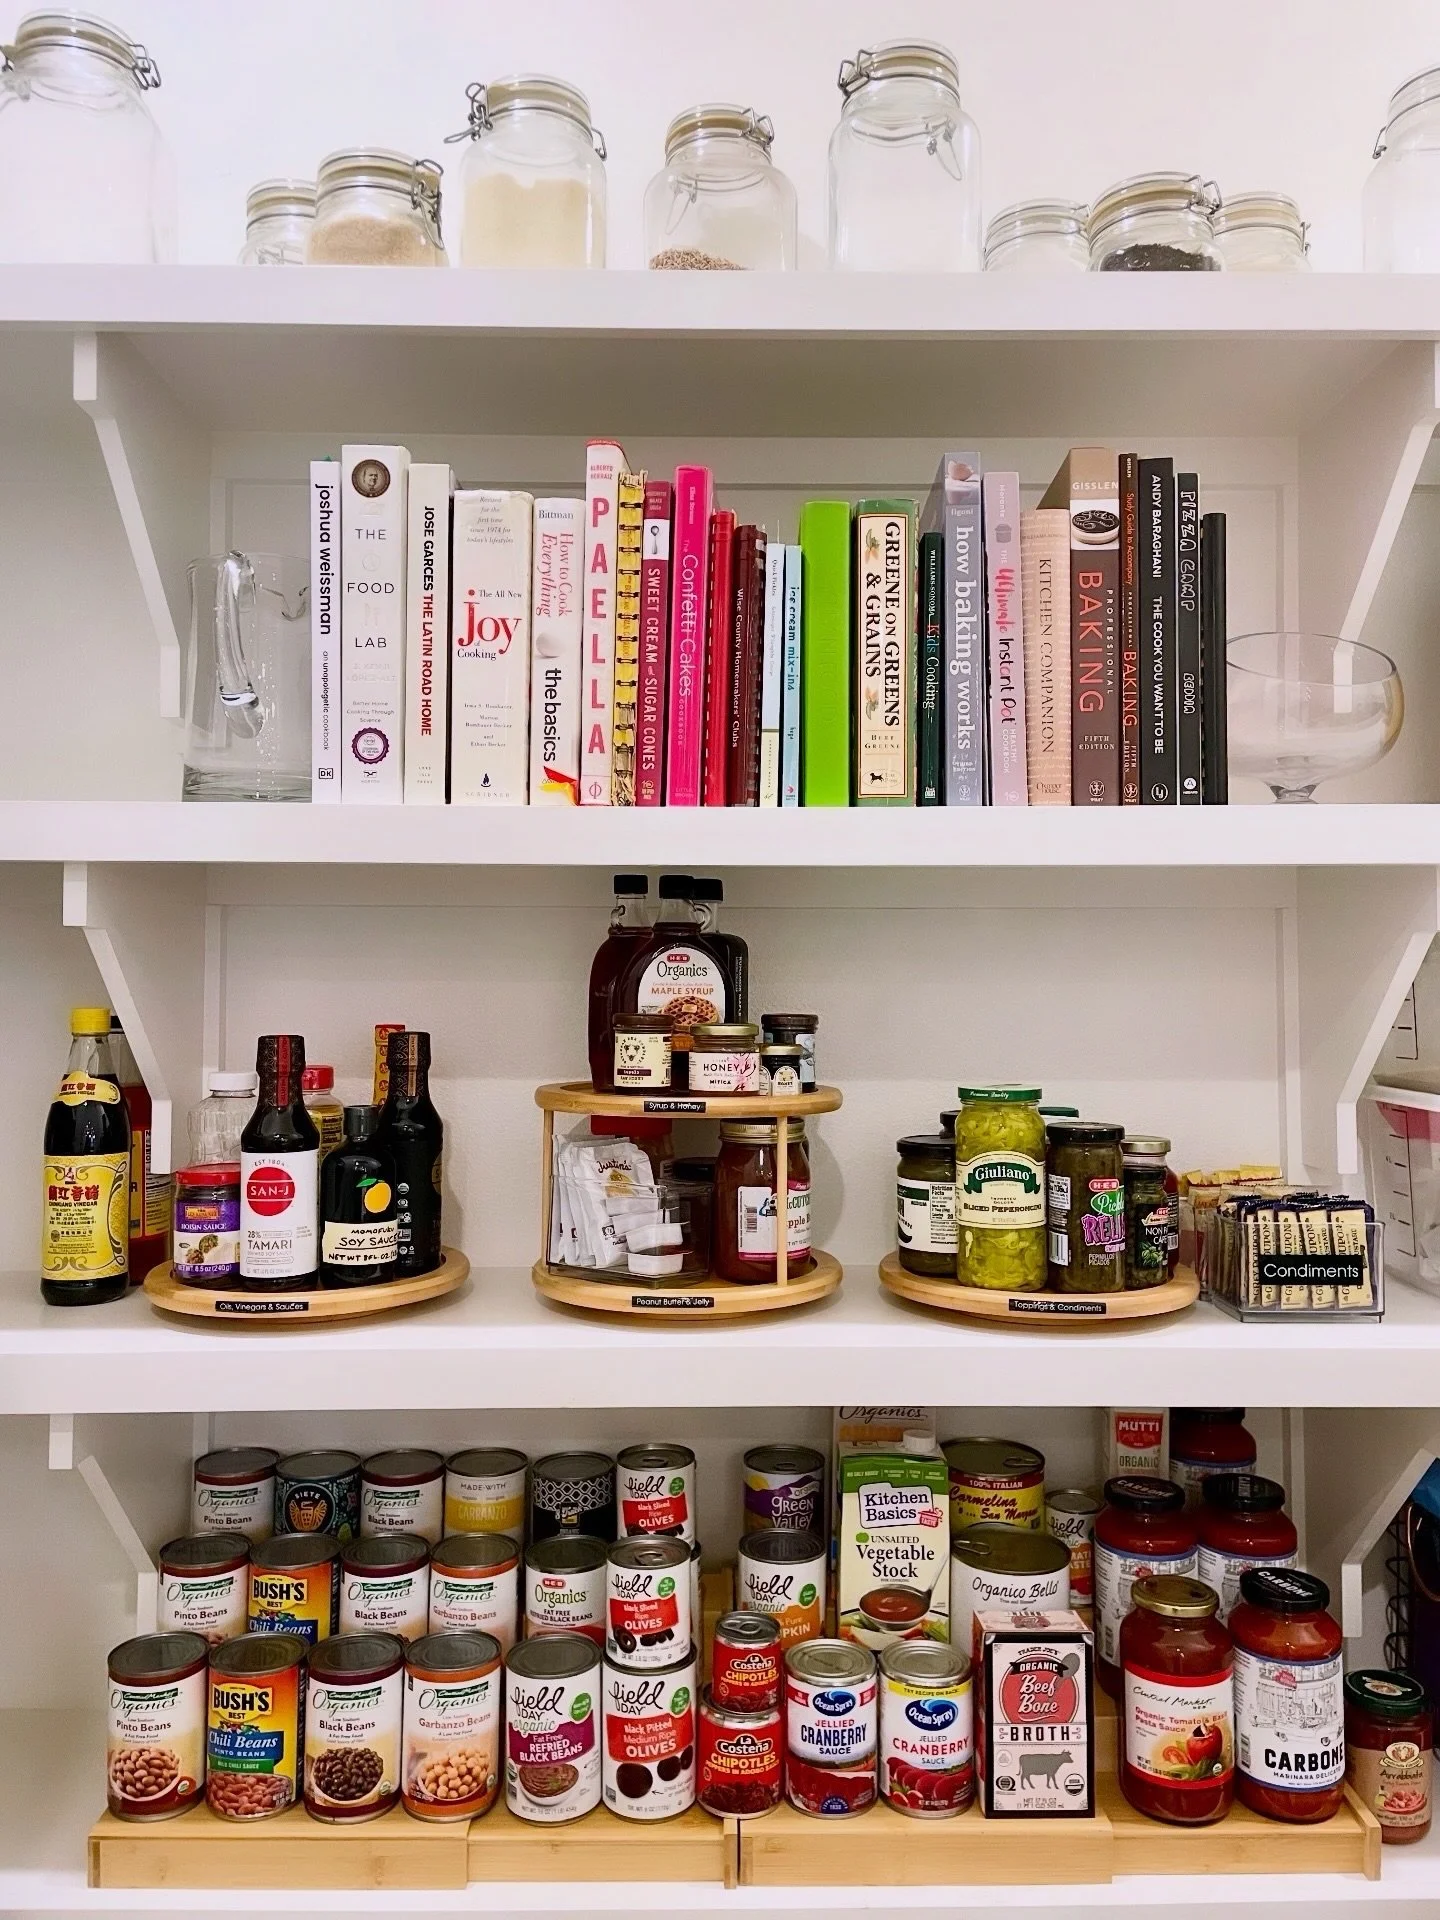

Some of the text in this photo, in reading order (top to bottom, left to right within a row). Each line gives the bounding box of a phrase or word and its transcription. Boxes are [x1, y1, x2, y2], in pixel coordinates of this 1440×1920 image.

[1072, 481, 1119, 490] GISSLEN
[355, 528, 387, 540] THE
[1126, 493, 1135, 585] Study Guide to Accompany
[315, 484, 334, 635] joshua weissman
[1180, 490, 1197, 612] PIZZA CAMP
[536, 533, 558, 617] Everything
[347, 582, 395, 594] FOOD
[681, 554, 699, 632] Confetti
[421, 506, 434, 736] JOSE GARCES THE LATIN ROAD HOME
[1151, 474, 1164, 754] ANDY BARAGHANI THE COOK YOU WANT TO BE
[588, 497, 610, 754] PAELLA
[735, 615, 744, 649] County
[865, 572, 882, 678] & GRAINS
[884, 522, 900, 727] GREENE ON GREENS
[355, 637, 387, 648] LAB
[787, 587, 800, 691] ice cream mix-ins
[950, 525, 978, 750] how baking works
[1079, 571, 1105, 713] BAKING
[1106, 588, 1114, 694] PROFESSIONAL
[457, 649, 497, 660] Cooking
[1039, 559, 1055, 753] KITCHEN COMPANION
[642, 568, 661, 770] SWEET CREAM SUGAR CONES
[678, 639, 697, 697] Cakes
[998, 638, 1015, 692] Instant
[733, 651, 743, 718] Homemakers'
[1123, 651, 1138, 727] BAKING
[543, 668, 562, 762] the basics
[1000, 698, 1017, 725] Pot
[732, 720, 740, 748] Clubs
[656, 961, 708, 981] Organics
[651, 987, 714, 996] MAPLE SYRUP
[703, 1063, 740, 1072] HONEY
[649, 1102, 669, 1111] Syrup
[677, 1103, 701, 1111] Honey
[597, 1158, 632, 1173] Justin's
[974, 1165, 1030, 1182] Giuliano
[250, 1184, 289, 1198] SAN-J
[247, 1240, 293, 1250] TAMARI
[339, 1231, 403, 1247] SOY SAUCE
[1263, 1263, 1359, 1278] Condiments
[235, 1303, 267, 1312] Vinegars
[267, 1303, 274, 1311] &
[275, 1302, 304, 1311] Sauces
[636, 1297, 662, 1306] Peanut
[662, 1297, 684, 1306] Butter
[692, 1297, 710, 1307] Jelly
[1014, 1300, 1049, 1311] Toppings
[1057, 1302, 1102, 1312] Condiments
[1118, 1421, 1160, 1432] MUTTI
[1119, 1455, 1159, 1469] ORGANIC
[864, 1491, 929, 1507] Kitchen
[949, 1486, 1018, 1508] Carmelina
[638, 1515, 674, 1528] OLIVES
[865, 1506, 917, 1522] Basics
[871, 1535, 920, 1544] UNSALTED
[855, 1544, 935, 1564] Vegetable
[872, 1562, 919, 1578] Stock
[253, 1579, 305, 1601] BUSH'S
[972, 1576, 1058, 1602] Organico Bello
[1257, 1570, 1314, 1598] CARBONE
[534, 1584, 587, 1608] Organics
[174, 1608, 228, 1620] Pinto Beans
[355, 1609, 408, 1621] Black Beans
[556, 1609, 571, 1617] FREE
[623, 1618, 663, 1630] OLIVES
[725, 1667, 777, 1682] CHIPOTLES
[1019, 1662, 1059, 1673] ORGANIC
[1020, 1674, 1056, 1697] Beef
[213, 1686, 271, 1712] BUSH'S
[1018, 1694, 1058, 1714] Bone
[1132, 1686, 1216, 1707] Central Market
[228, 1711, 246, 1720] BEST
[418, 1712, 492, 1730] Garbanzo Beans
[520, 1710, 546, 1721] DAY
[815, 1719, 855, 1728] JELLIED
[116, 1719, 172, 1732] Pinto Beans
[318, 1719, 376, 1732] Black Beans
[1009, 1725, 1071, 1742] BROTH
[209, 1730, 279, 1749] Chili Beans
[800, 1723, 867, 1747] CRANBERRY
[918, 1735, 947, 1743] JELLIED
[214, 1748, 235, 1757] PINTO
[519, 1743, 583, 1763] BLACK BEANS
[529, 1739, 570, 1753] REFRIED
[625, 1738, 677, 1758] OLIVES
[719, 1742, 769, 1755] Costeña
[819, 1746, 852, 1755] SAUCE
[892, 1737, 970, 1756] CRANBERRY
[710, 1751, 776, 1769] CHIPOTLES
[921, 1757, 945, 1765] SAUCE
[1264, 1743, 1345, 1773] CARBONE
